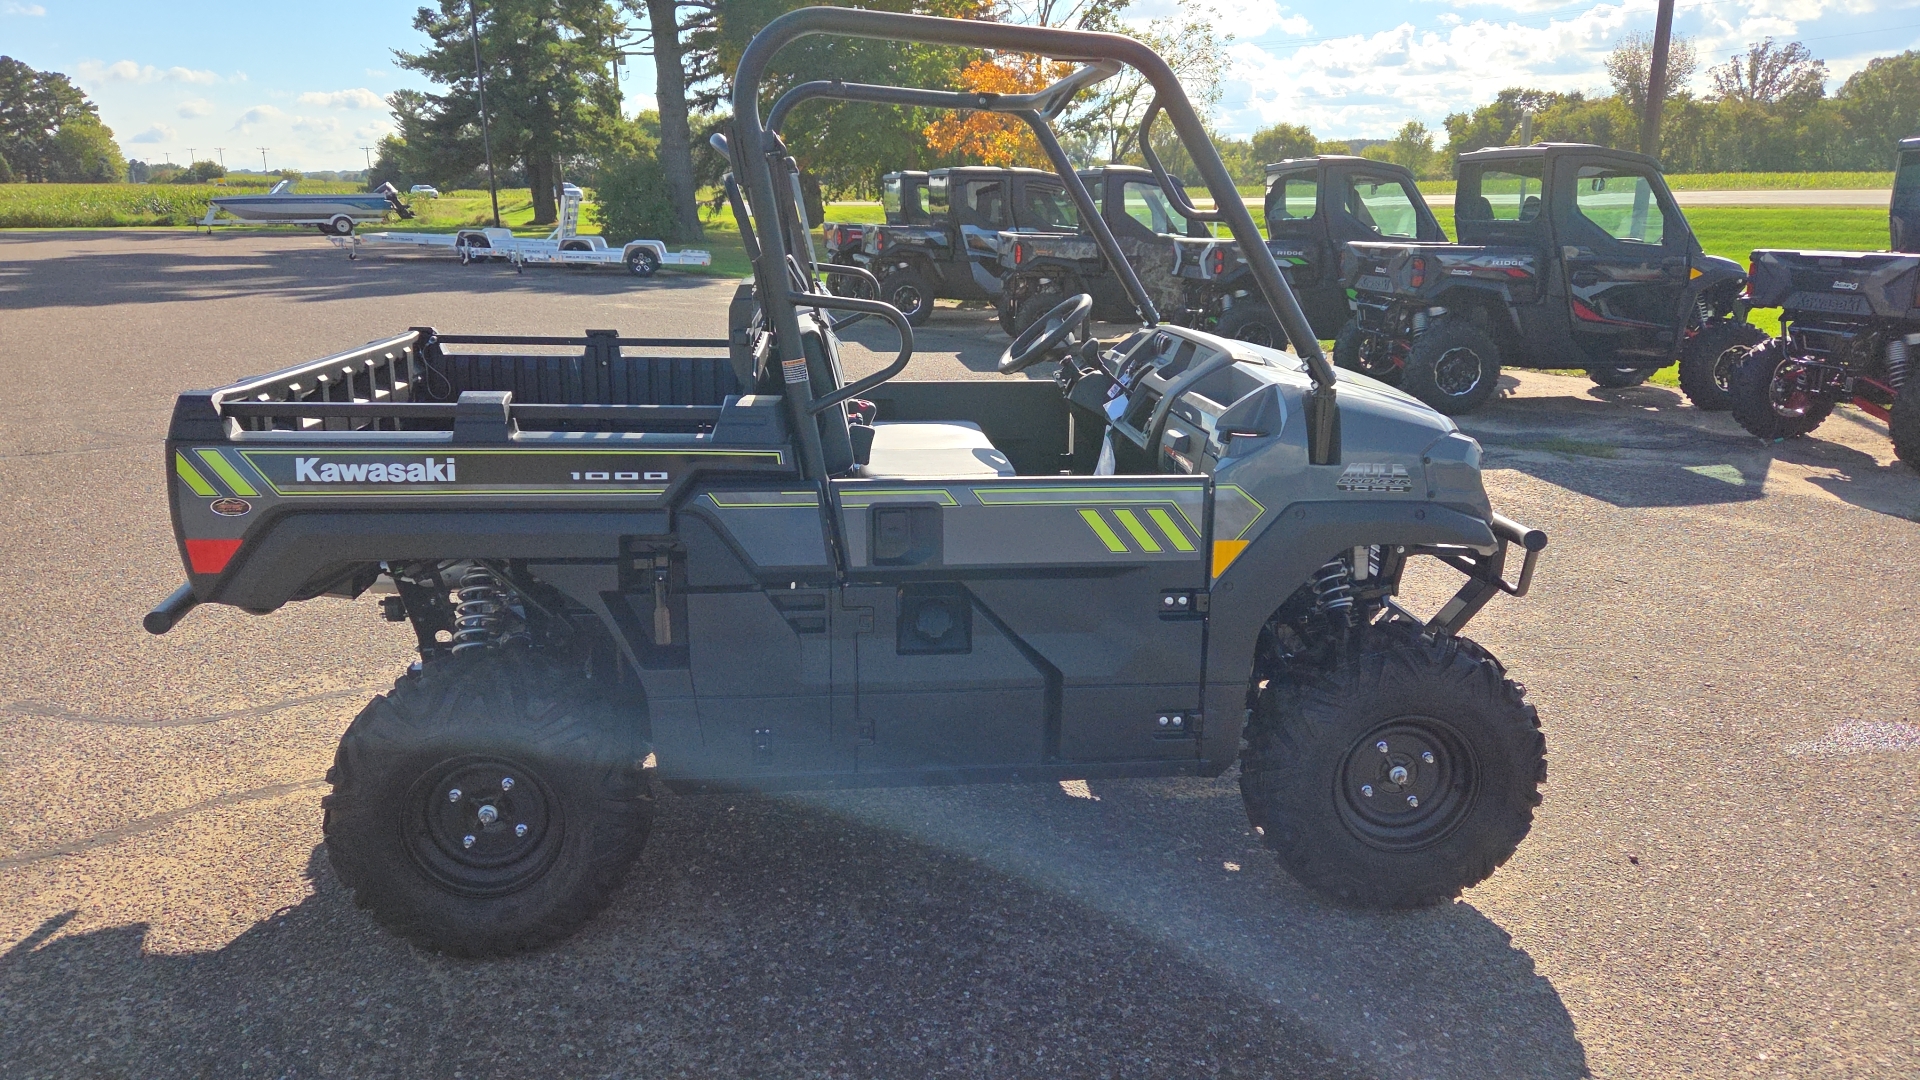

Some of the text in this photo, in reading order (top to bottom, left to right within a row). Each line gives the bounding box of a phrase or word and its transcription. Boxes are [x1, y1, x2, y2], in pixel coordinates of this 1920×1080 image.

[295, 457, 456, 482] Kawasaki
[570, 472, 668, 480] 1000
[1341, 463, 1410, 477] MULE
